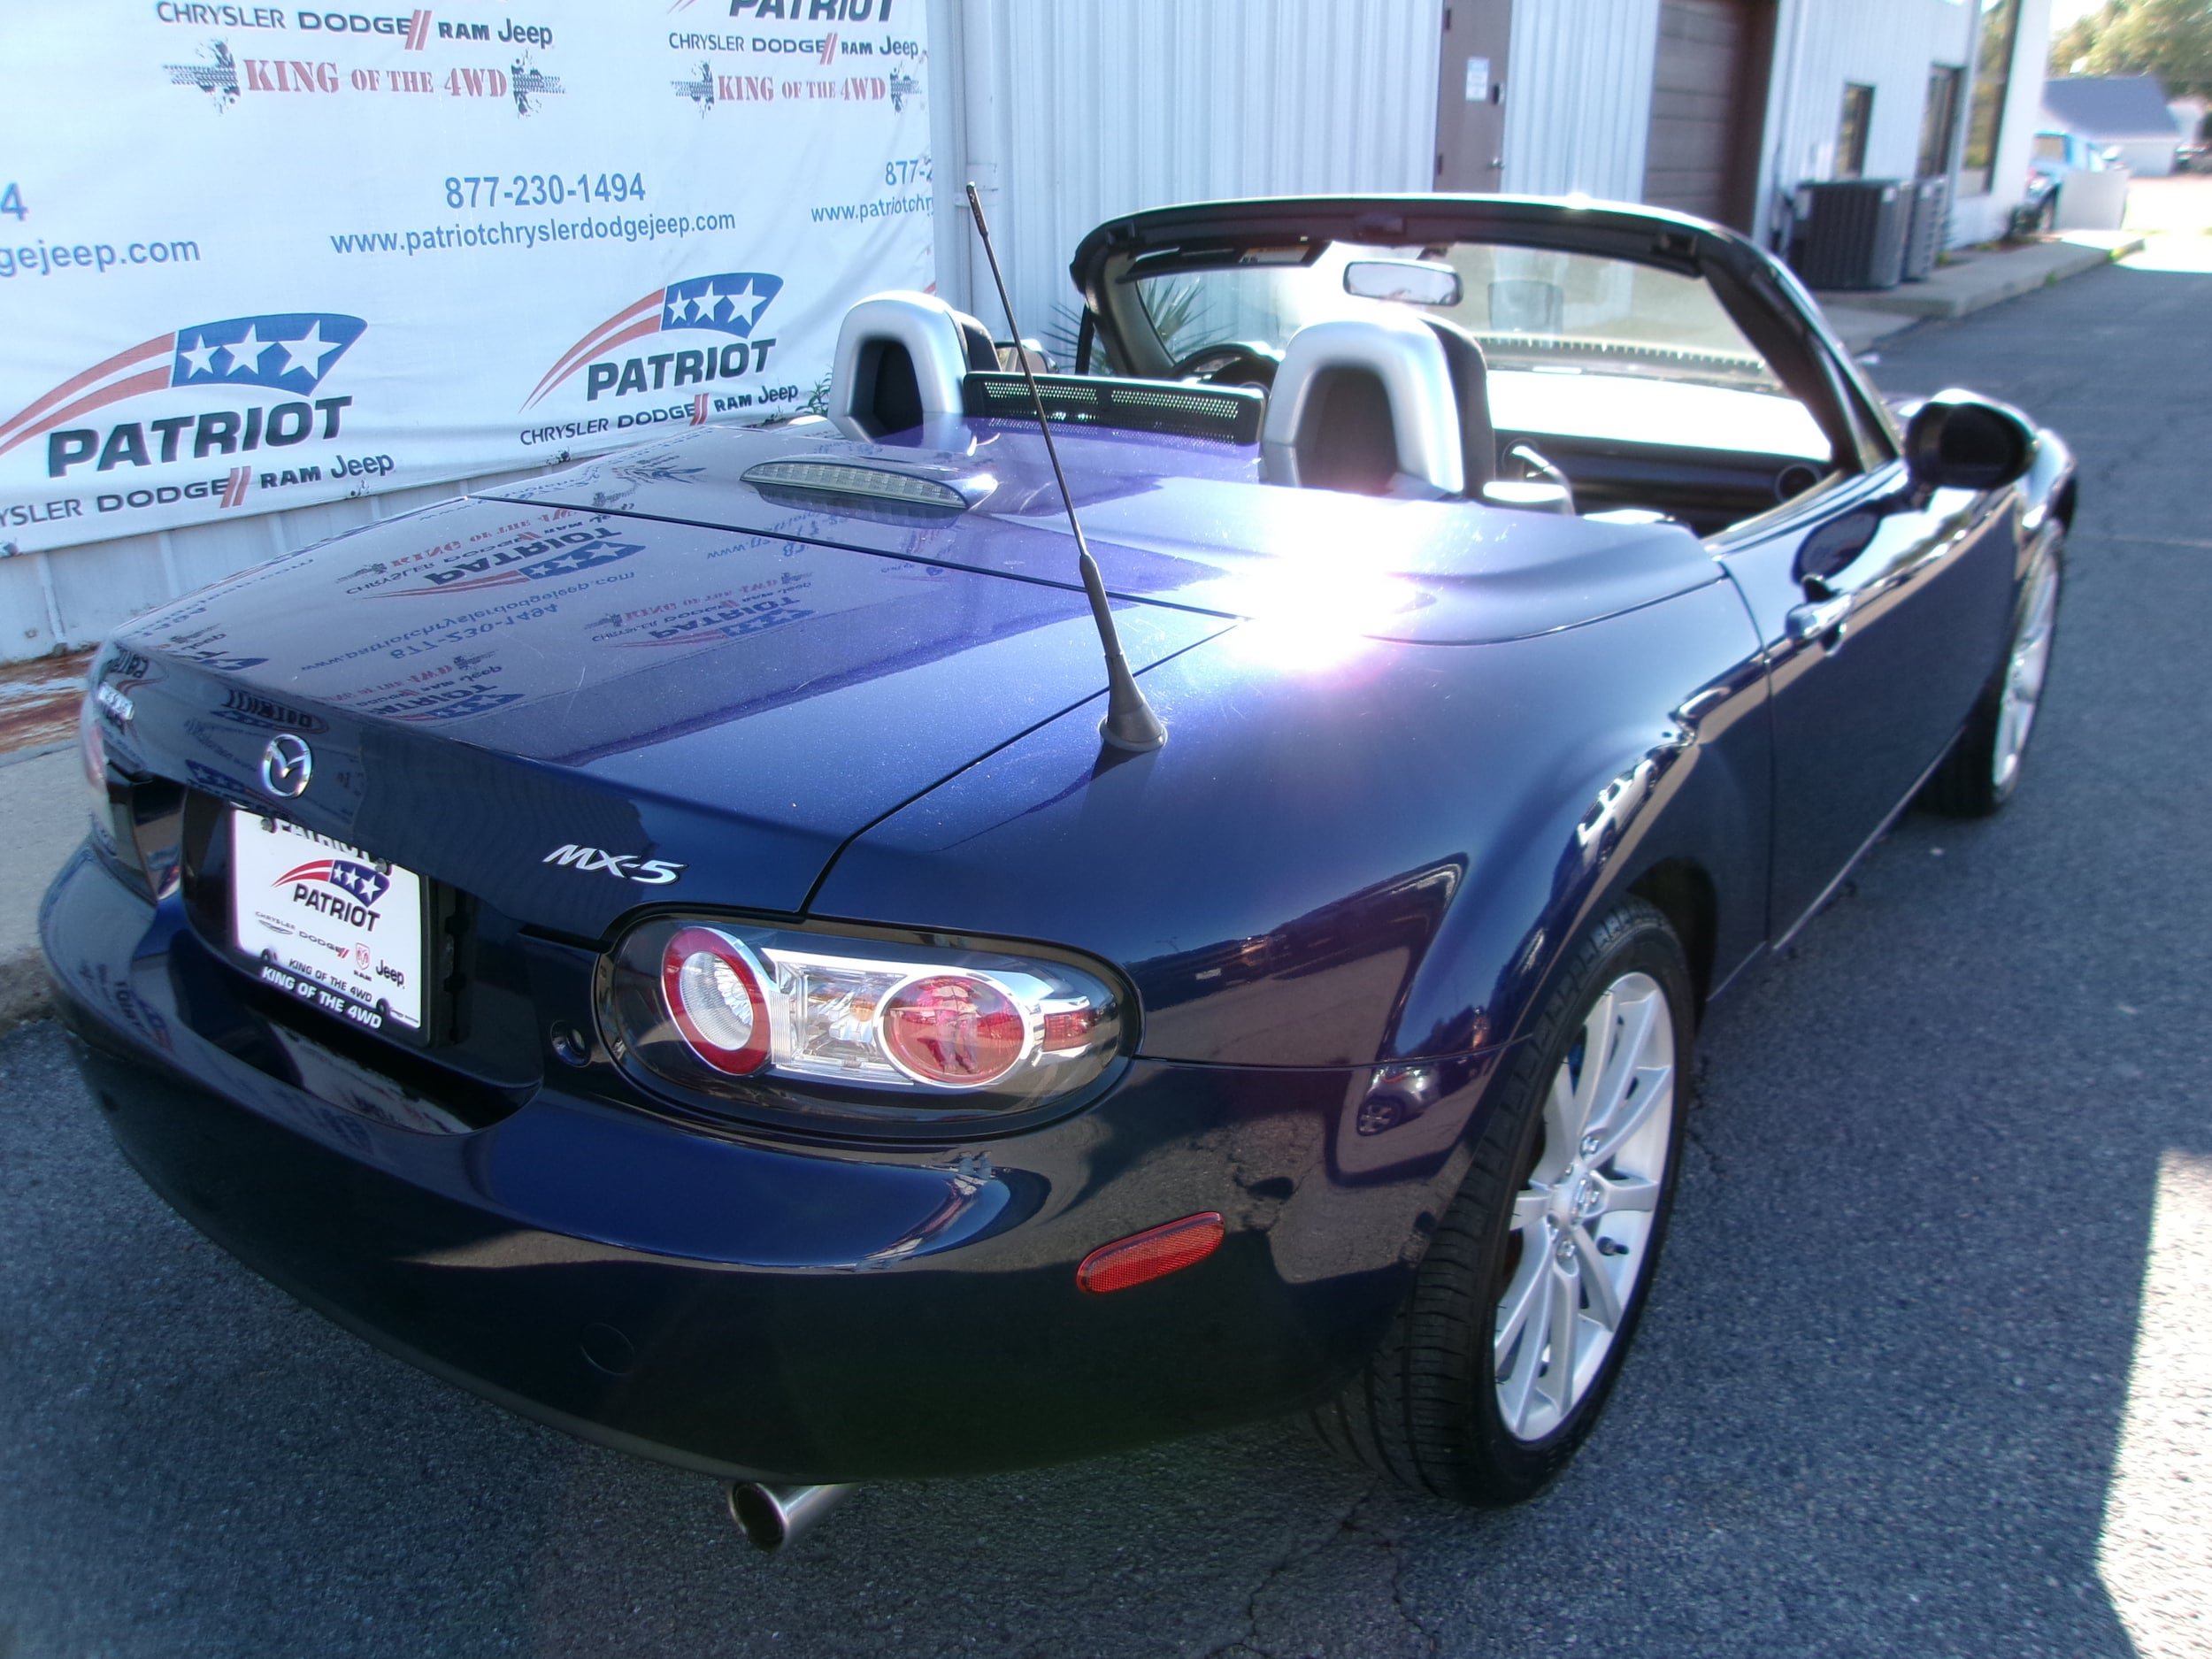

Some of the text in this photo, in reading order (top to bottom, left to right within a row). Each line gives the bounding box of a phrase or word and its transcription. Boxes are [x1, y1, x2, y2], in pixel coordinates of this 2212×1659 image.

[157, 1, 553, 49] CHRYSLER DODGE RAM Jeep
[669, 32, 918, 59] CHRYSLER DODGE RAM Jeep
[242, 59, 508, 97] KING OF THE 4WD
[718, 75, 886, 102] KING OF THE 4WD
[0, 181, 28, 221] 4
[445, 172, 646, 210] 877-230-1494
[810, 192, 934, 223] www.patriotchr
[330, 211, 736, 257] www.patriotchryslerdodgejeep.com
[0, 240, 201, 277] gejeep.com
[587, 337, 777, 402] PATRIOT
[519, 384, 798, 446] CHRYSLER DODGE RAM Jeep
[49, 396, 353, 478] PATRIOT
[97, 479, 229, 513] DODGE
[260, 465, 322, 489] RAM
[330, 452, 396, 480] Jeep
[541, 844, 686, 884] MX-5
[255, 910, 296, 930] CHRYSLER
[293, 882, 381, 932] PATRIOT
[288, 957, 373, 1003] KING OF THE 4WD
[375, 958, 404, 987] Jeep
[262, 966, 296, 991] KING
[297, 981, 315, 999] OF
[319, 990, 346, 1013] THE
[347, 1004, 382, 1030] 4WD
